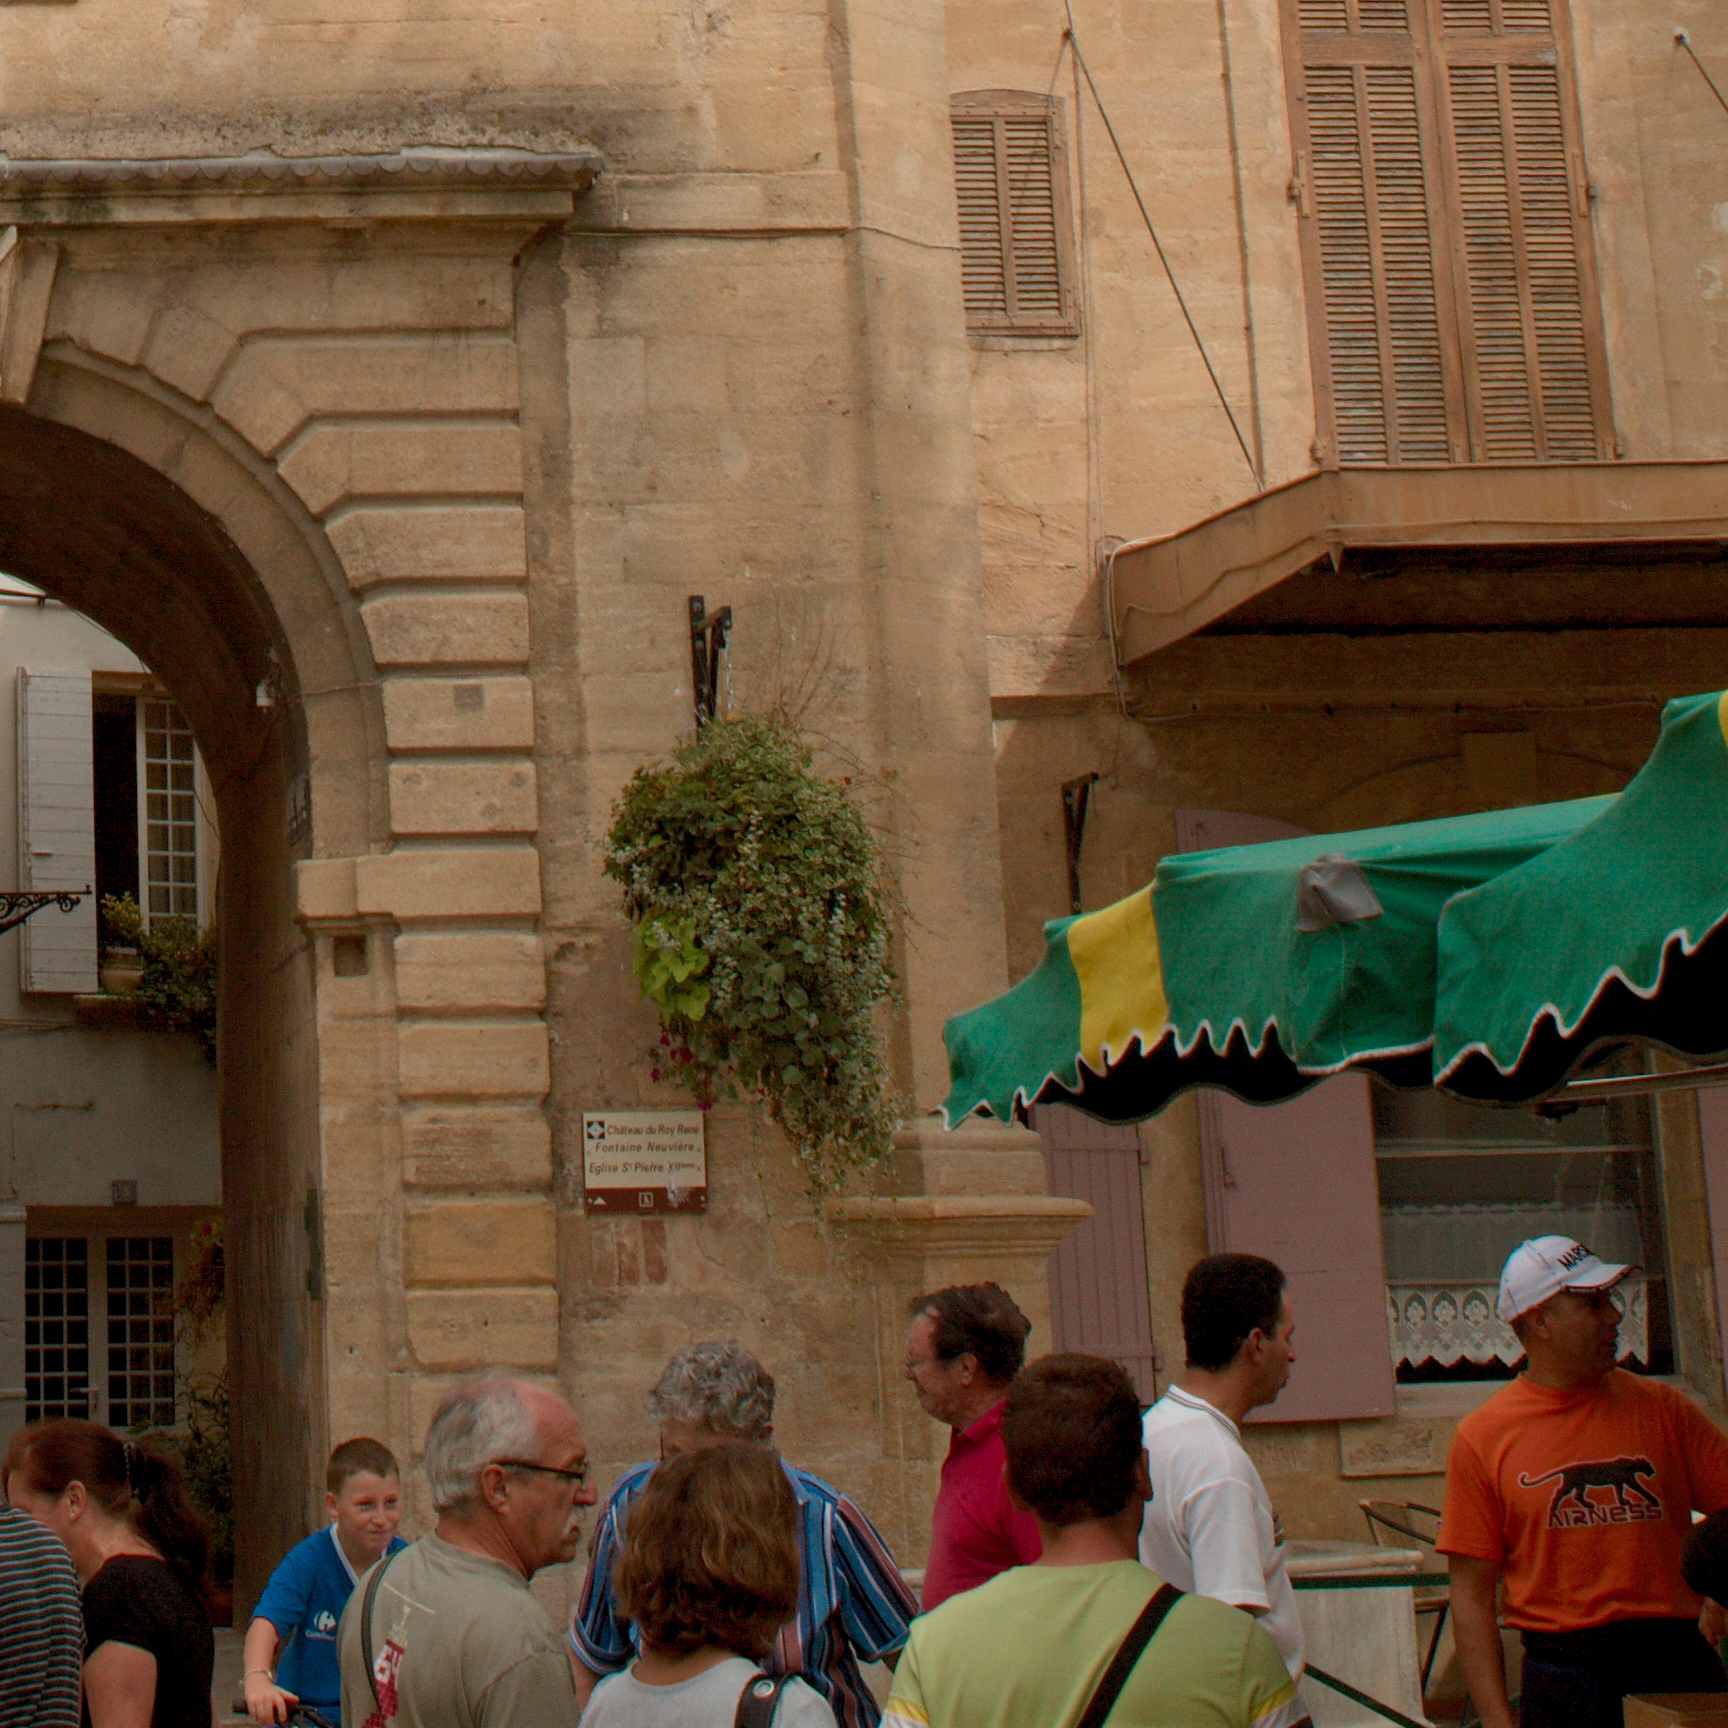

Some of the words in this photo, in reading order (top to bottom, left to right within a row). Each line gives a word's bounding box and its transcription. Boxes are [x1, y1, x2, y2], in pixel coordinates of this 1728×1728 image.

[645, 1125, 657, 1135] du
[658, 1125, 676, 1136] Roy
[595, 1142, 642, 1153] Fontaine
[647, 1142, 694, 1152] Neuvière
[634, 1161, 663, 1173] Pierre
